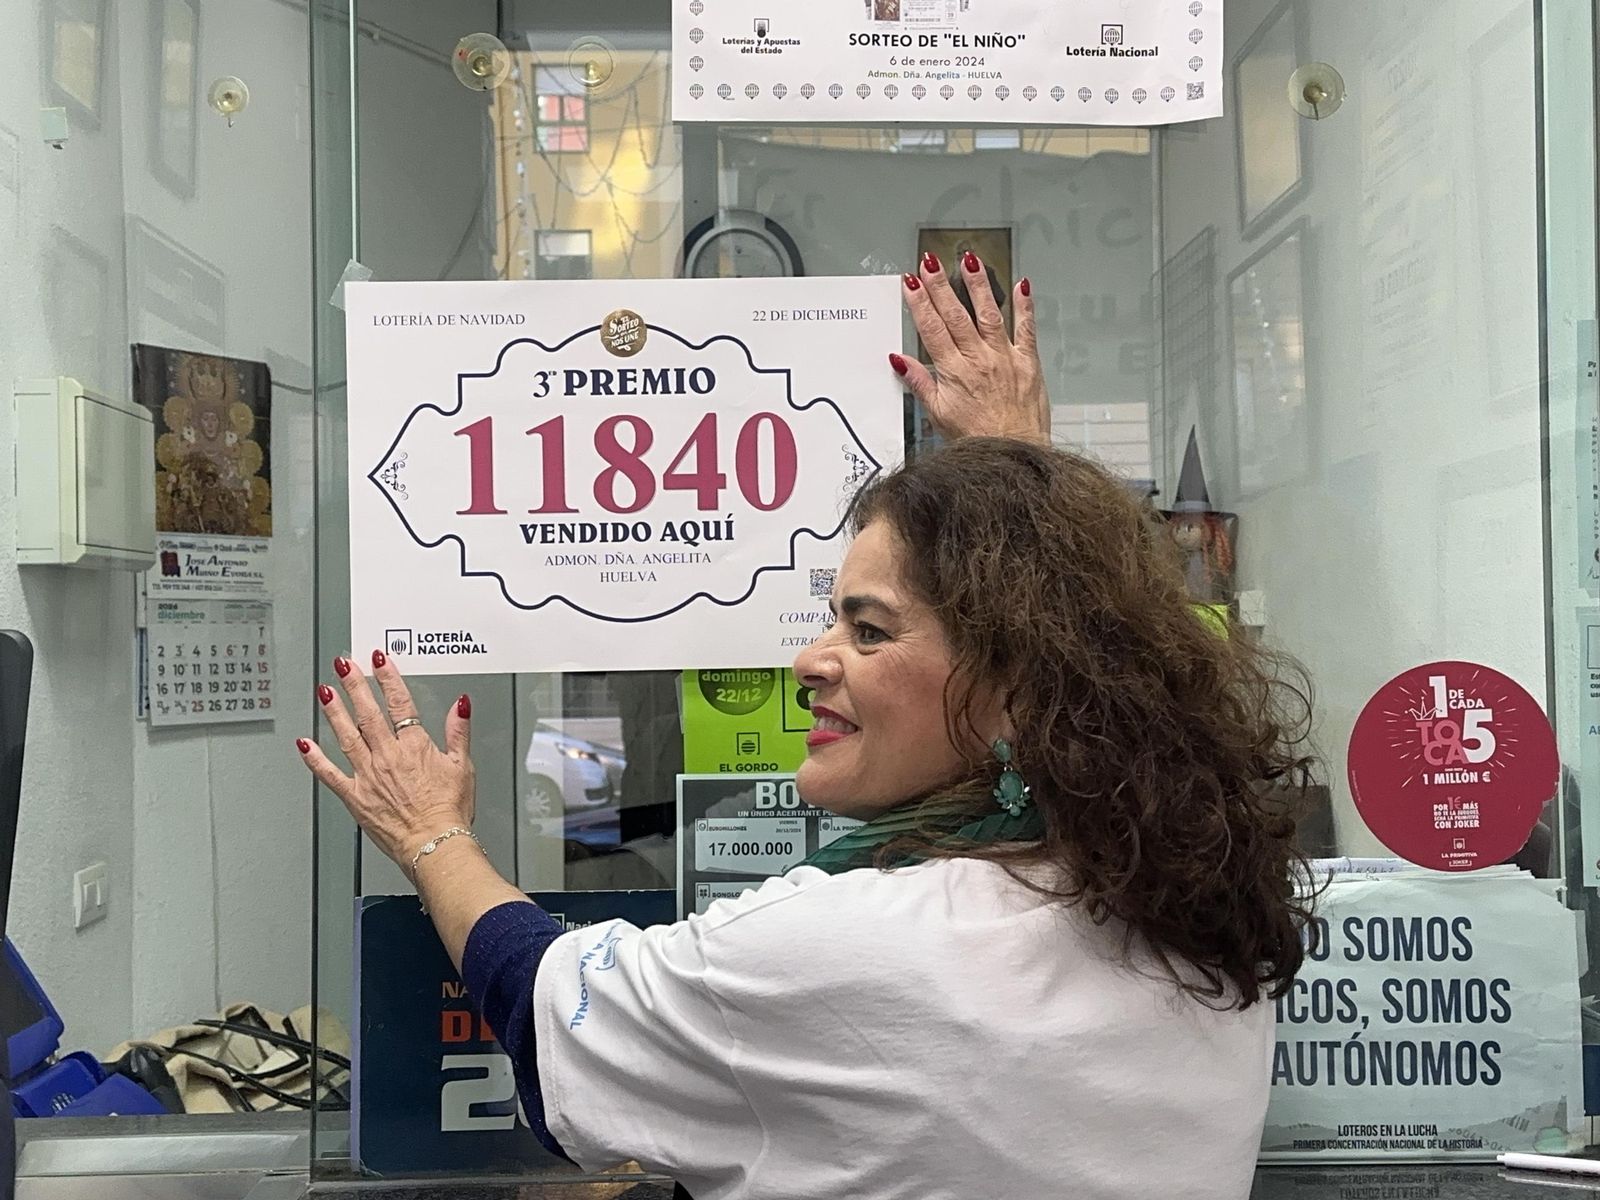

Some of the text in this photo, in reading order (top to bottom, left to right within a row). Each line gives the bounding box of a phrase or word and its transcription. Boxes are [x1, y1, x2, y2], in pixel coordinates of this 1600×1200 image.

[764, 38, 801, 46] Apuestas
[849, 31, 1026, 48] SORTEO DE "EL NIÑO"
[1066, 46, 1158, 58] Lotería Nacional
[889, 56, 986, 67] 6 de enero 2024
[868, 69, 901, 79] Admon.
[926, 70, 961, 81] Angelita
[968, 71, 1002, 80] HUELVA
[374, 312, 526, 326] LOTERÍA DE NAVIDAD
[752, 309, 868, 322] 22 DE DICIEMBRE
[624, 331, 639, 343] UNE
[564, 368, 716, 396] PREMIO
[454, 412, 798, 515] 11840
[520, 514, 734, 547] VENDIDO AQUÍ
[545, 552, 712, 567] ADMON. DÑA. ANGELITA
[600, 570, 657, 582] HUELVA
[158, 610, 205, 620] diciembre
[418, 630, 474, 644] LOTERÍA
[158, 644, 266, 658] 2 3 4 5 6 7 8
[418, 644, 488, 656] NACIONAL
[158, 662, 268, 676] 9 10 11 12 13 14 15
[702, 668, 772, 684] domingo
[156, 680, 270, 695] 16 17 18 19 20 21 22
[716, 688, 762, 703] 22/12
[1429, 676, 1464, 718] 1 DE
[192, 700, 204, 712] 25
[209, 700, 222, 712] 26
[226, 699, 238, 712] 27
[242, 698, 254, 710] 28
[258, 698, 271, 710] 29
[1450, 698, 1485, 710] CADA
[1462, 708, 1496, 764] 5
[720, 762, 778, 772] EL GORDO
[1423, 769, 1491, 785] 1 MILLÓN €
[755, 781, 816, 809] BO
[1462, 801, 1478, 810] MÁS
[1434, 820, 1480, 829] CON JOKER
[708, 842, 794, 856] 17.000.000
[1342, 916, 1473, 962] SOMOS
[1274, 978, 1512, 1030] ICOS, SOMOS
[1272, 1032, 1502, 1086] AUTÓNOMOS
[1338, 1124, 1378, 1136] LOTEROS
[1380, 1125, 1392, 1136] EN
[1394, 1125, 1406, 1136] LA
[1408, 1124, 1438, 1136] LUCHA
[1294, 1140, 1326, 1150] PRIMERA
[1327, 1138, 1388, 1150] CONCENTRACIÓN
[1390, 1140, 1426, 1149] NACIONAL
[1428, 1140, 1436, 1148] DE
[1438, 1139, 1448, 1148] LA
[1450, 1138, 1482, 1148] HISTORIA
